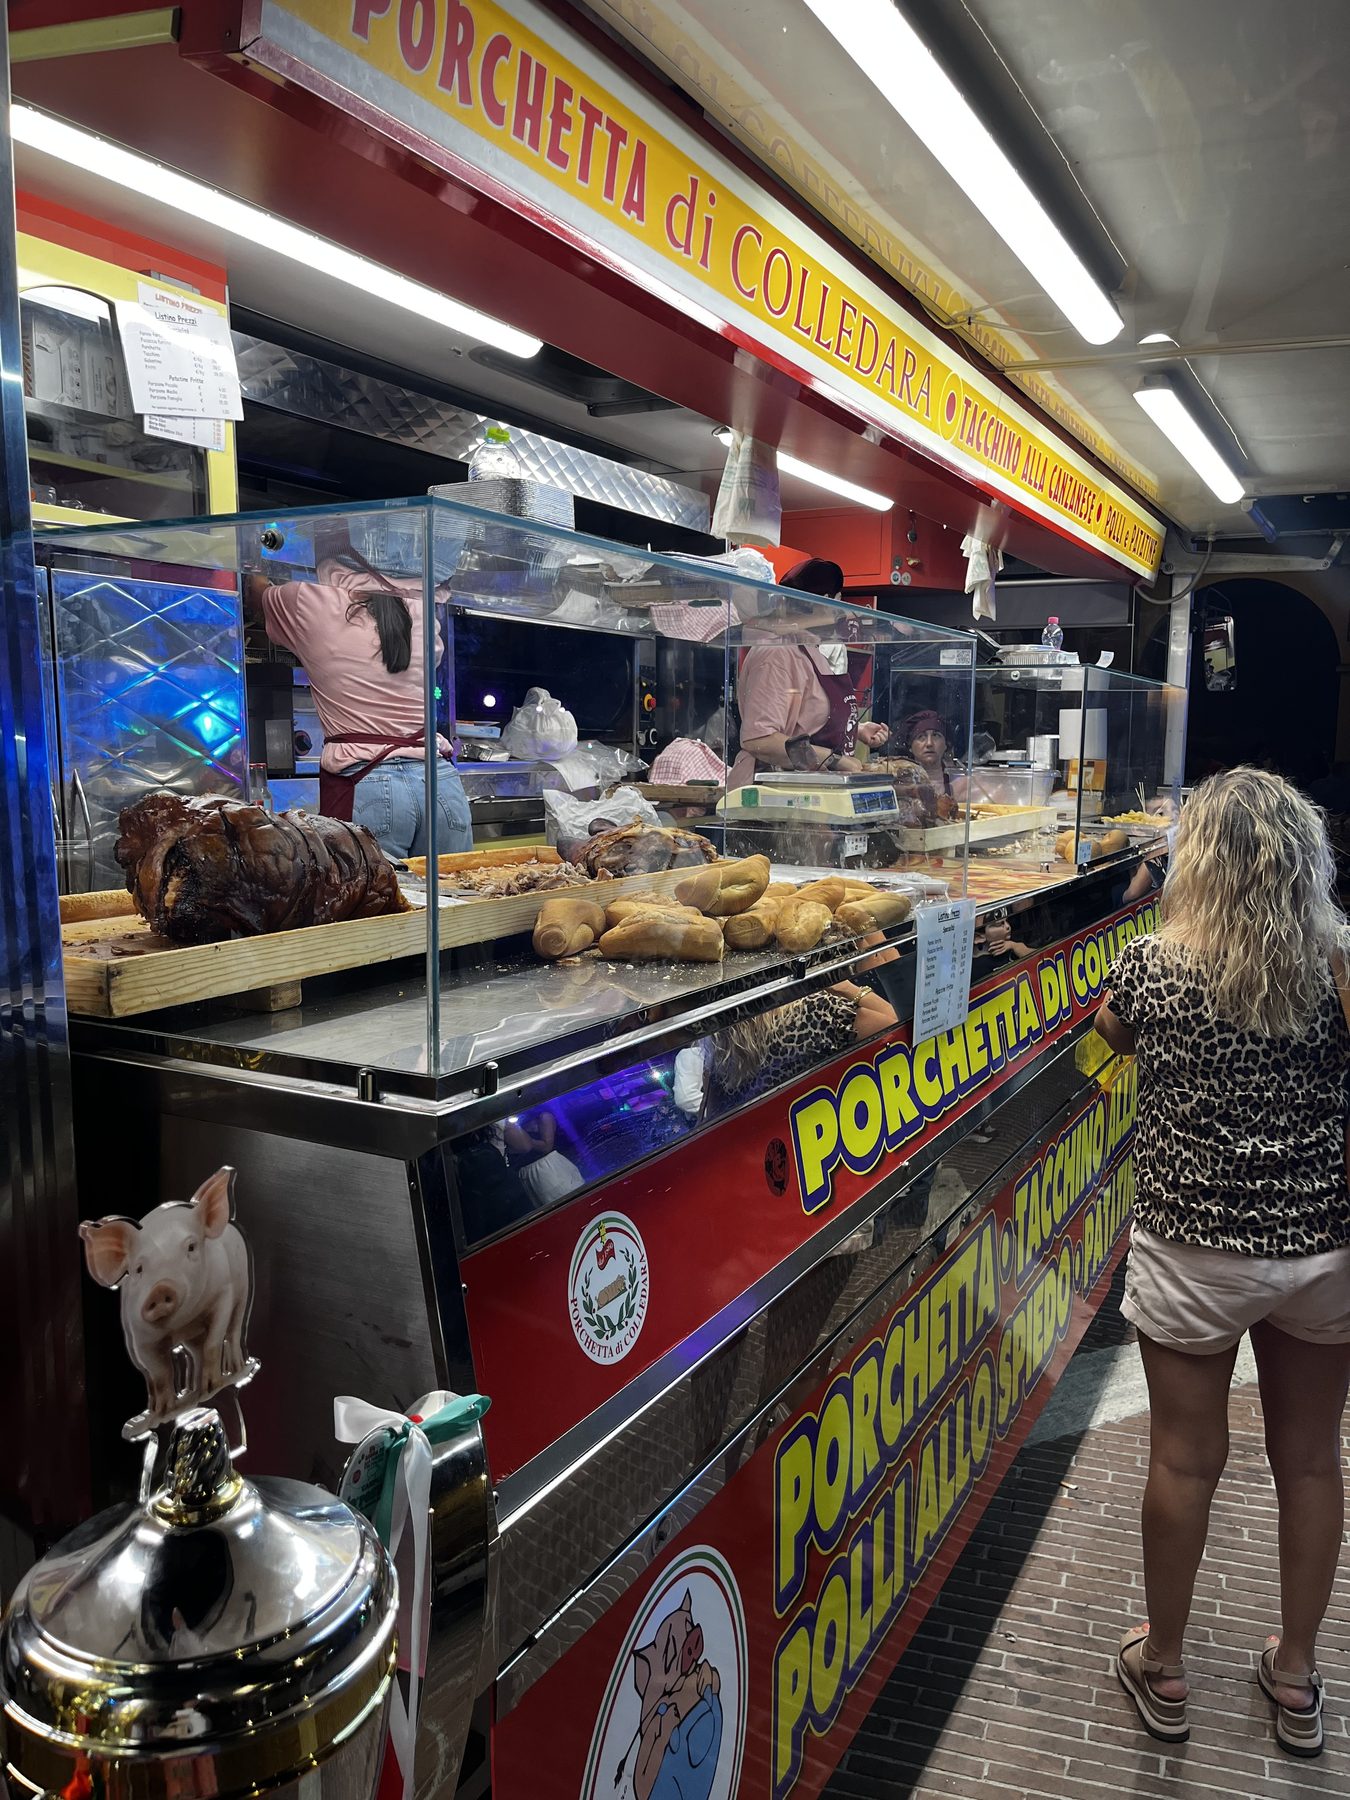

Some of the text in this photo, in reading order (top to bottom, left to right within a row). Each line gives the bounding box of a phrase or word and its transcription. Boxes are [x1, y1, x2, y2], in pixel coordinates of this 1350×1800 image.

[154, 312, 198, 325] Listino Prezzi
[664, 175, 717, 272] di
[730, 223, 933, 421] COLLEDARA
[959, 395, 1023, 476] TACCHINO
[1020, 444, 1050, 494] ALLA
[1047, 462, 1097, 526] CANZANESE
[1103, 503, 1126, 545] POLLI
[1123, 532, 1129, 549] e
[1128, 523, 1158, 566] PATATINE
[792, 975, 1042, 1207] PORCHETTA
[1037, 953, 1072, 1031] DI
[570, 1254, 648, 1359] PORCHETTA di COLLEDARA
[777, 1217, 998, 1606] PORCHETTA
[1015, 1095, 1106, 1282] TACCHINO
[773, 1469, 909, 1794] POLLI
[912, 1355, 994, 1576] ALLO
[997, 1242, 1071, 1433] SPIEDO
